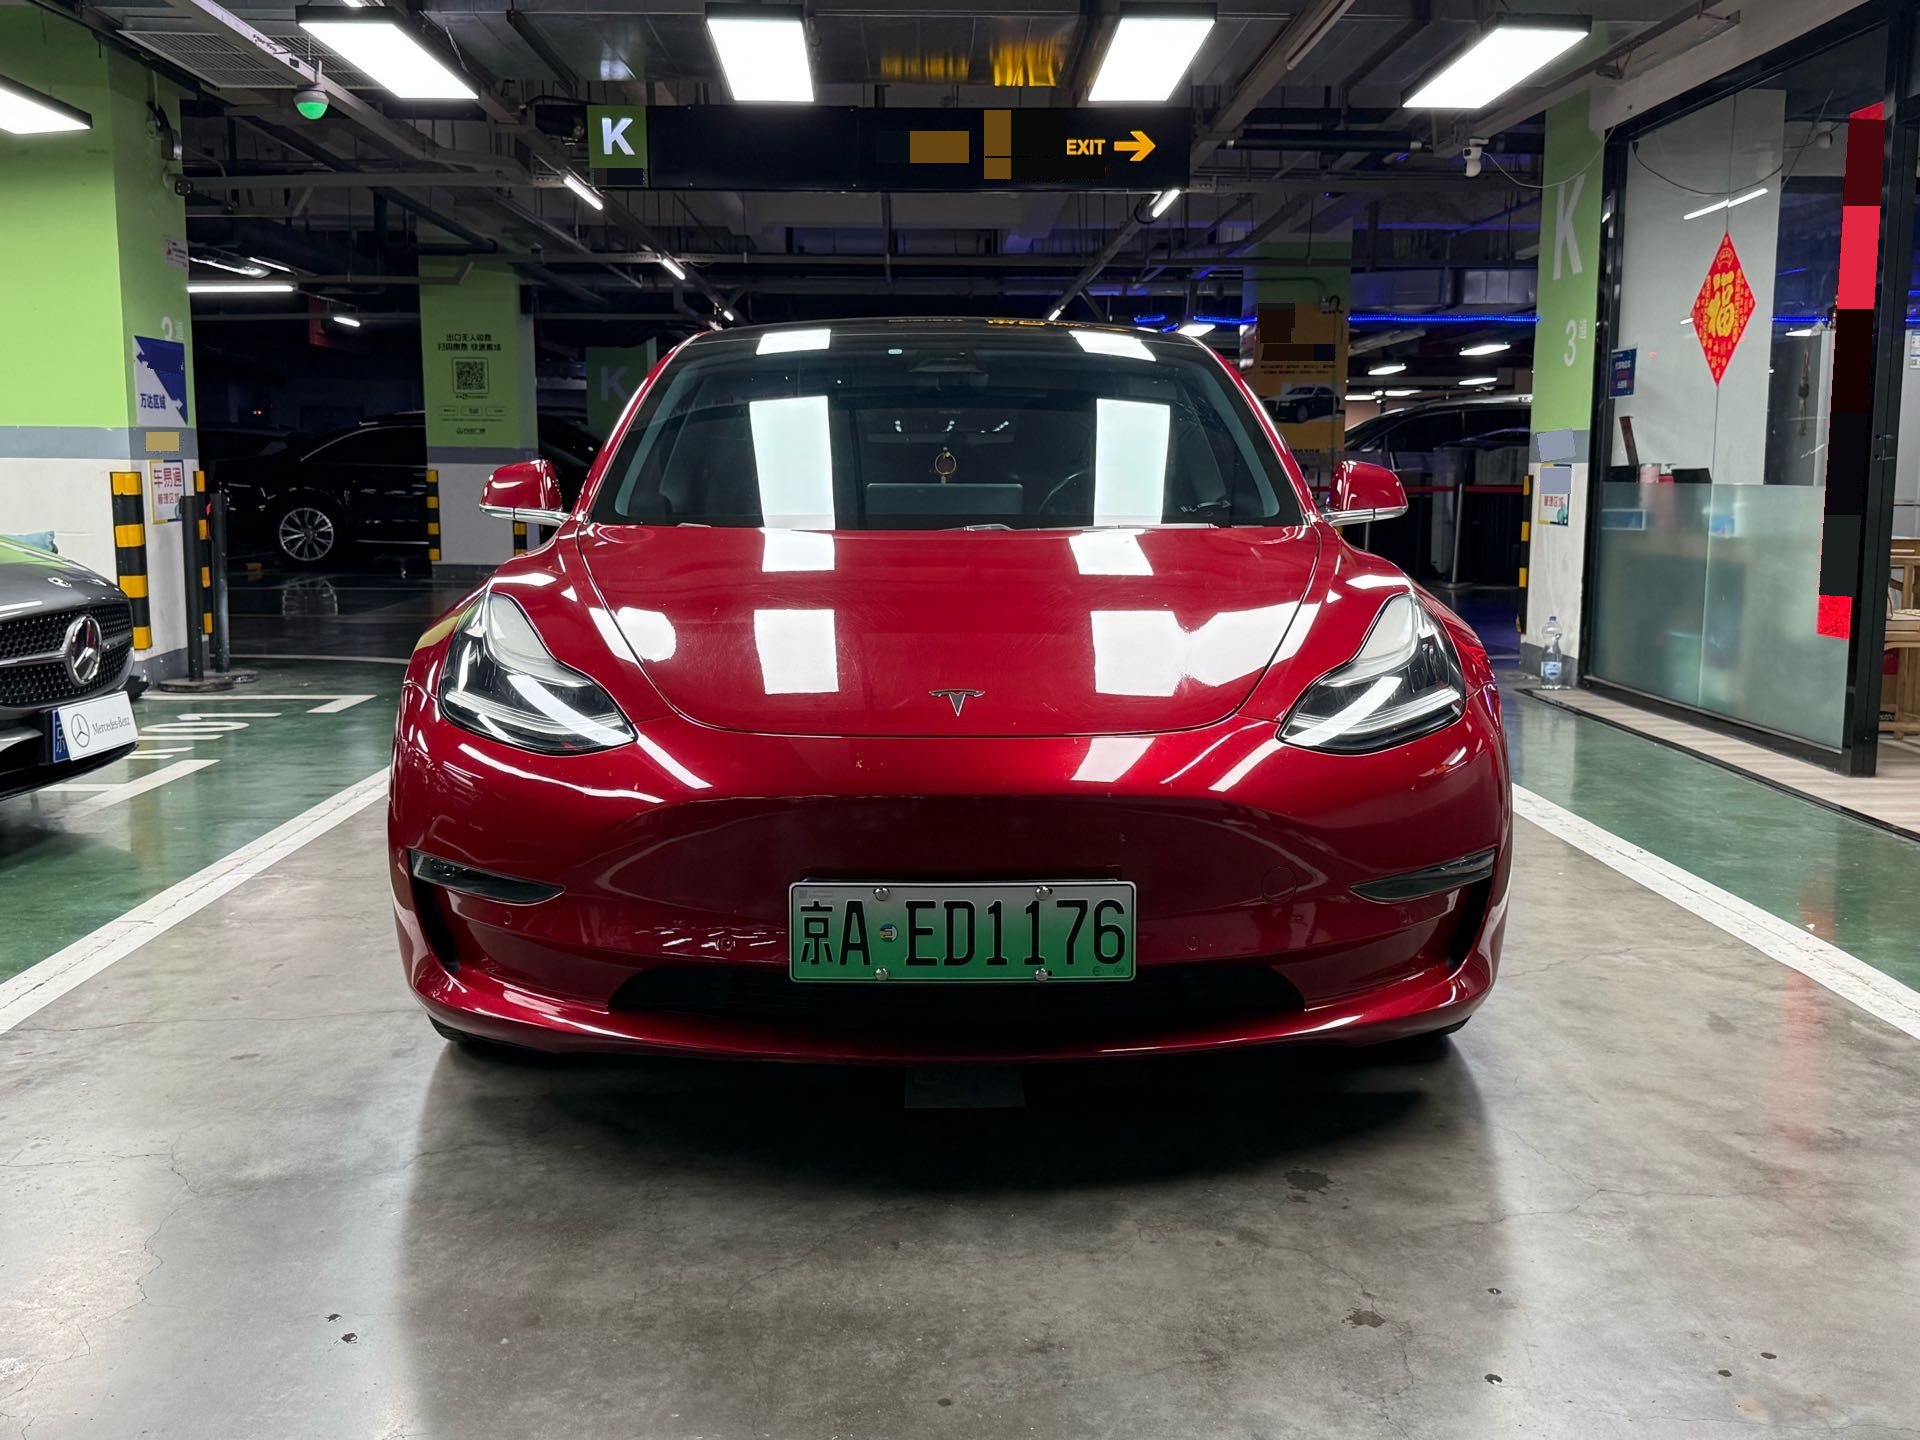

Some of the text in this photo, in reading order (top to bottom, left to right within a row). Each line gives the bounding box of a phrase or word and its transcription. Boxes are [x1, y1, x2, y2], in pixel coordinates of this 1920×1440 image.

[601, 116, 636, 156] K
[1066, 139, 1106, 156] EXIT
[1552, 173, 1587, 281] K
[1706, 270, 1735, 338] 福
[1564, 319, 1578, 368] 3
[600, 366, 629, 401] K
[140, 393, 167, 410] 万达区域
[153, 467, 183, 488] 车易通
[92, 716, 131, 736] Mercedes-Benz
